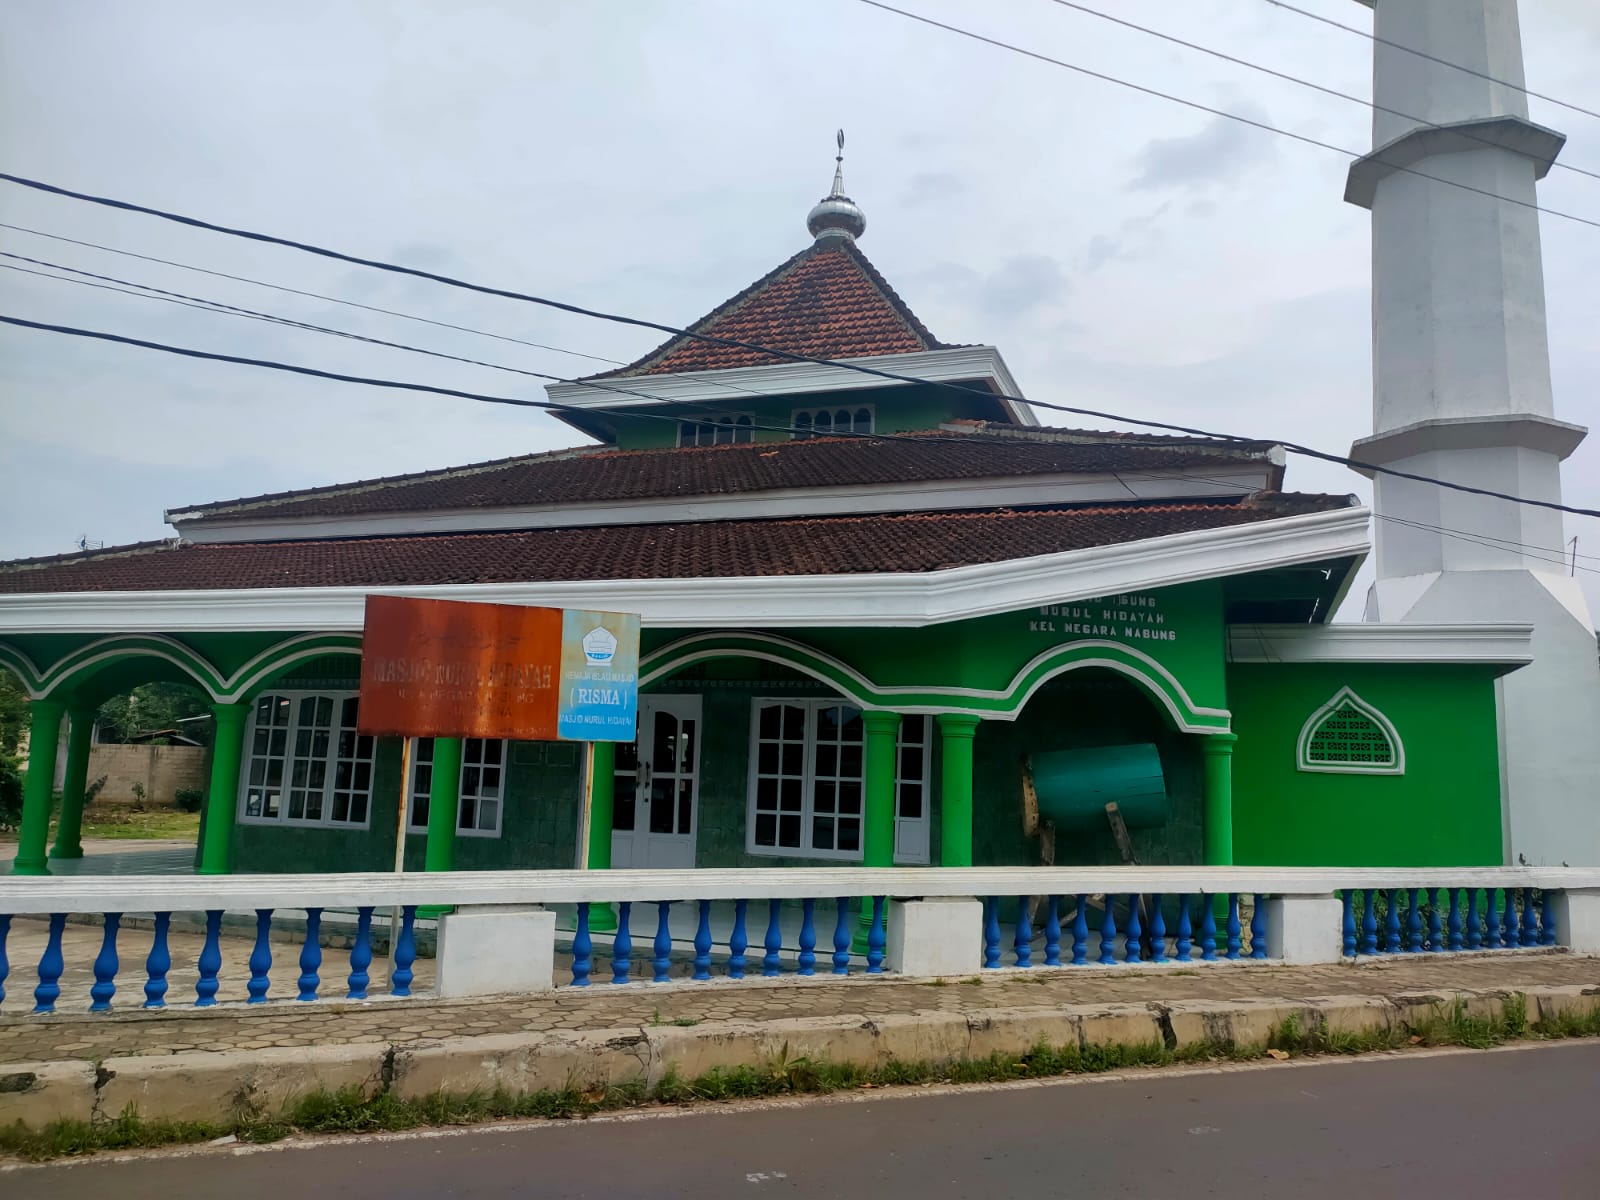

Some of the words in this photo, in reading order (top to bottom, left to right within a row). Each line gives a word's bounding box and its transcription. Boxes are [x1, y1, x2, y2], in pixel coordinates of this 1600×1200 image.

[1103, 609, 1164, 624] HIDAYAH
[1029, 620, 1056, 632] KEL
[1064, 622, 1117, 636] NEGARA
[1124, 626, 1176, 641] NABUNG
